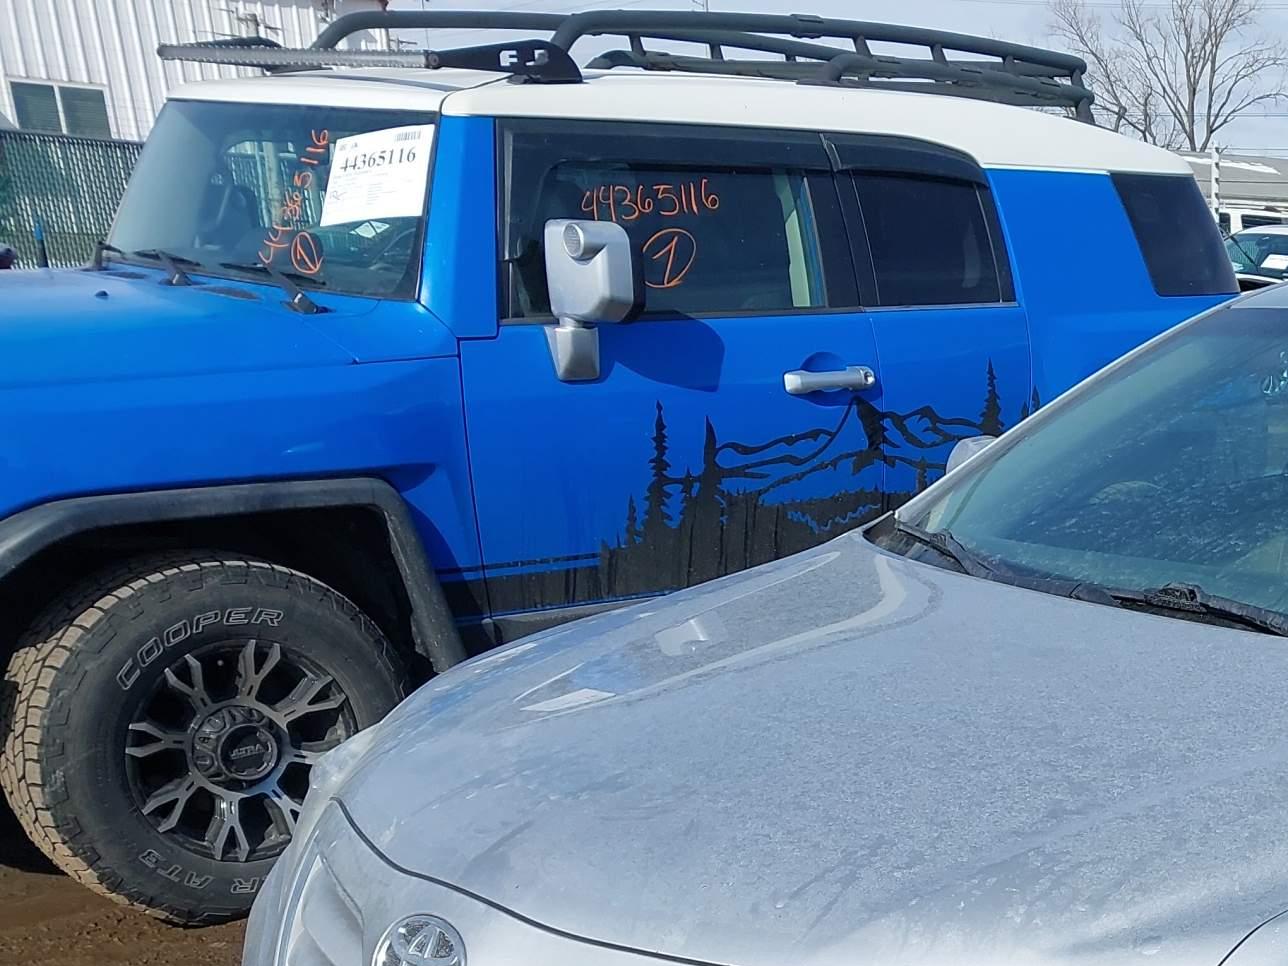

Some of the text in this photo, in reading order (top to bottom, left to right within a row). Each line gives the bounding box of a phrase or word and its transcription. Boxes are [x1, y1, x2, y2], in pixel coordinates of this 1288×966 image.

[339, 146, 417, 173] 44365116
[581, 178, 720, 222] 44365116
[116, 606, 284, 691] COOPER
[138, 848, 214, 889] AT3
